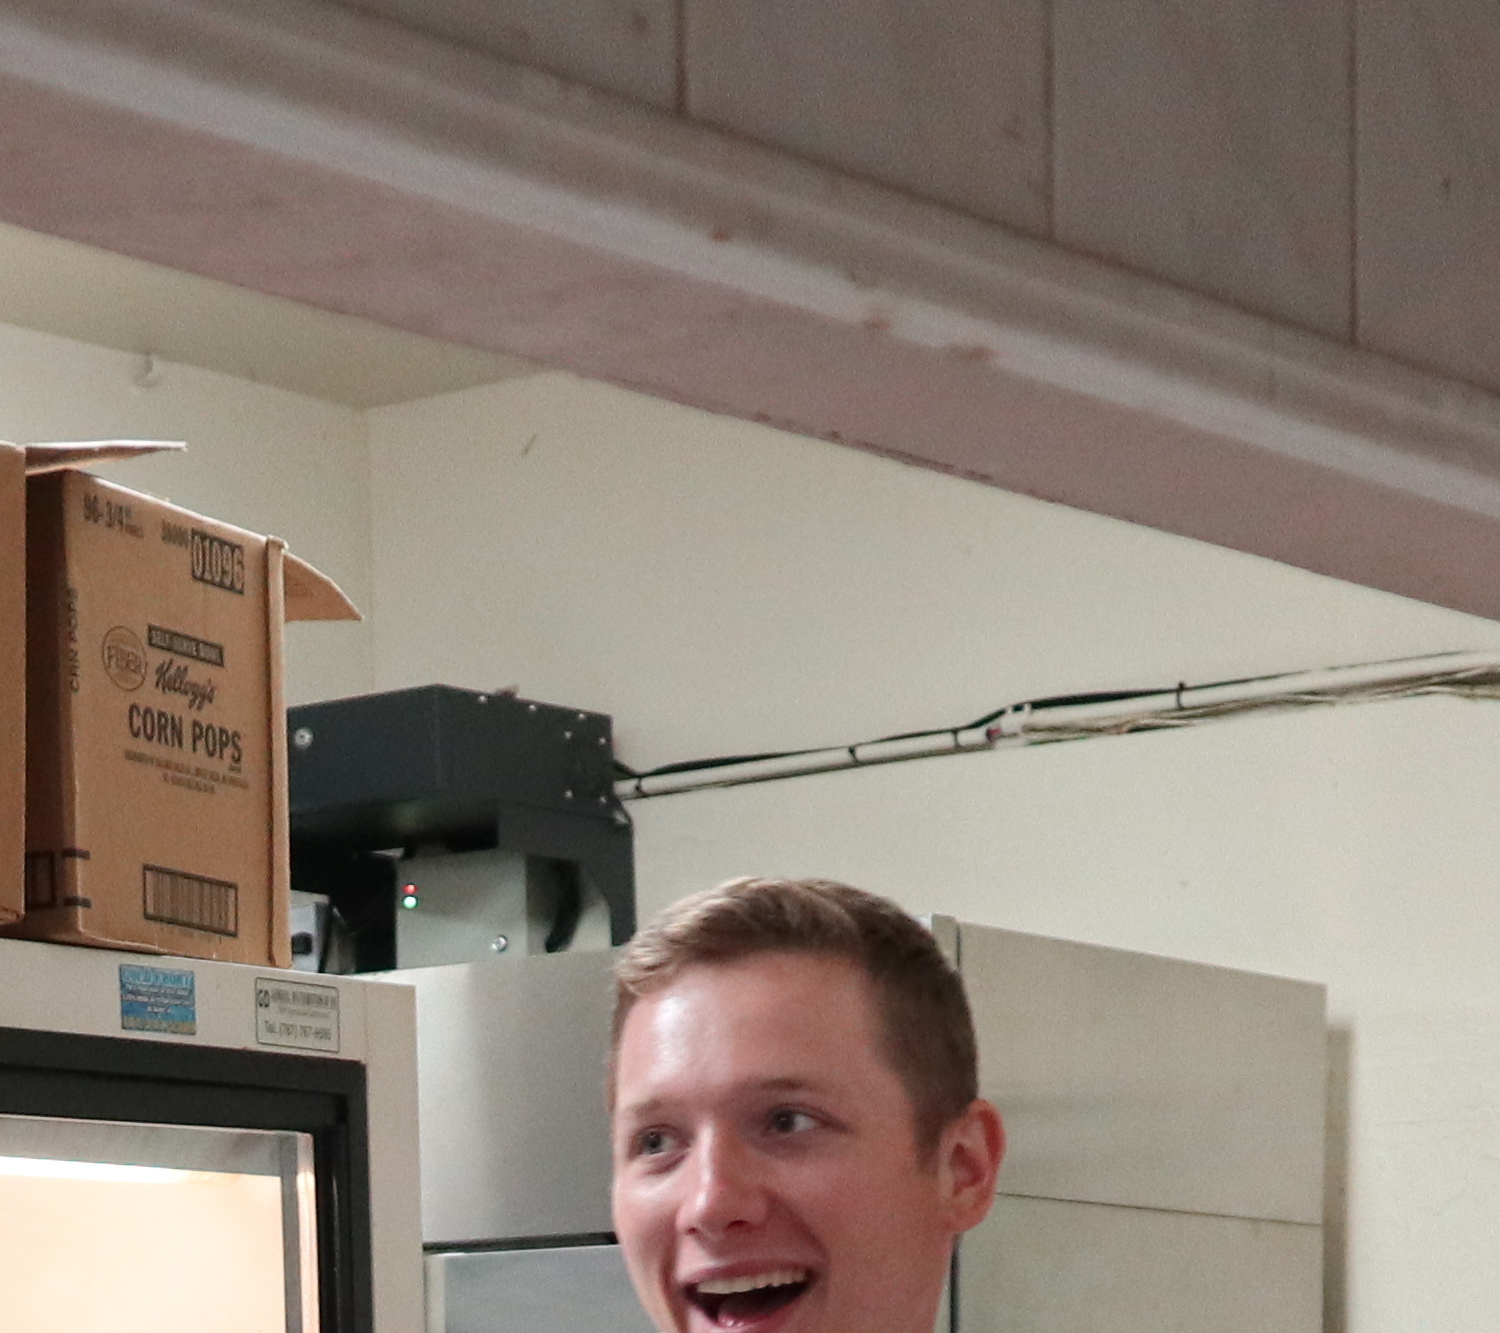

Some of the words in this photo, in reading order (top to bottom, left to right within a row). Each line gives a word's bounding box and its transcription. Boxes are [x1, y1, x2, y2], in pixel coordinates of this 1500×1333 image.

[155, 657, 217, 712] Kellogg's
[128, 702, 184, 750] CORN
[192, 719, 242, 765] POPS
